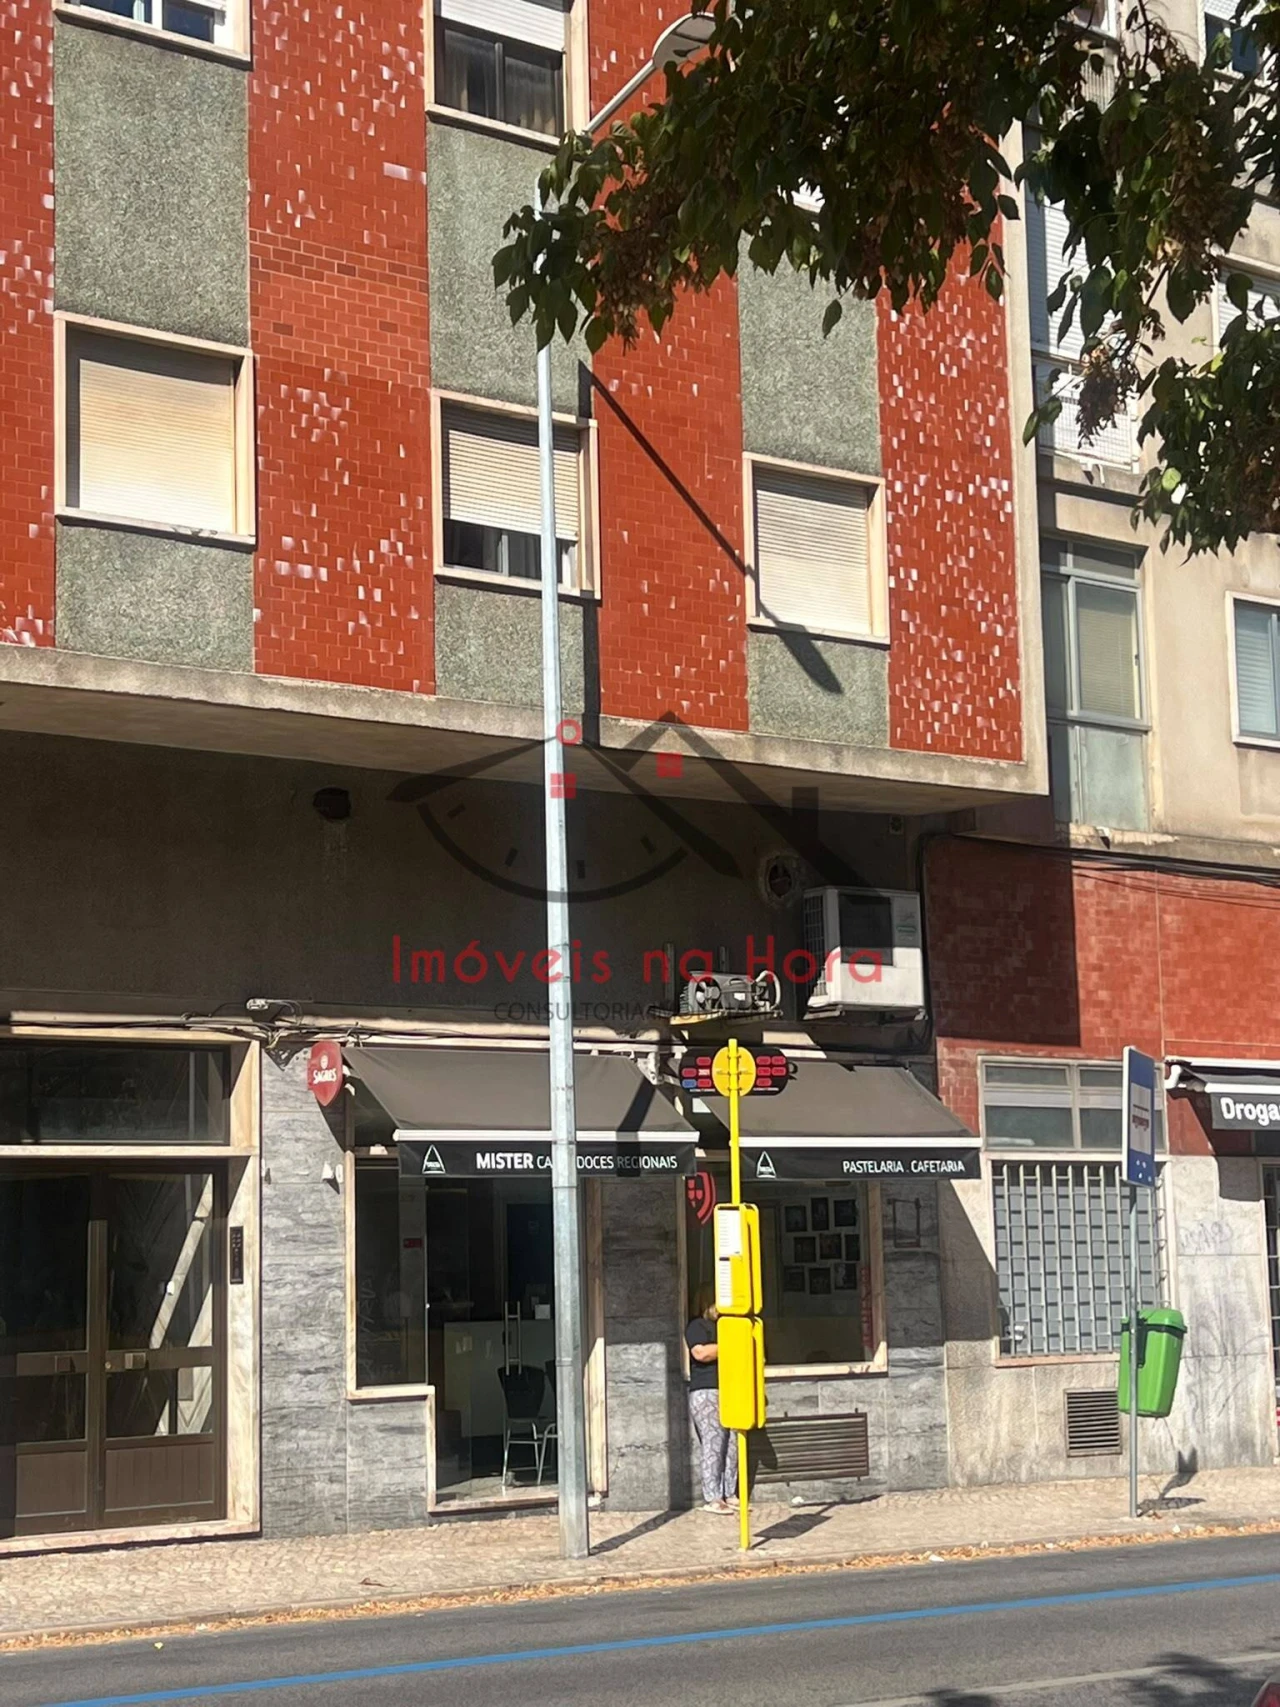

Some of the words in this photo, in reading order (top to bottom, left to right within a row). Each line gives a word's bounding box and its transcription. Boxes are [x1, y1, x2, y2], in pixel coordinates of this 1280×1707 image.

[1220, 1096, 1280, 1127] Droga
[475, 1152, 533, 1170] MISTER
[576, 1155, 614, 1169] DOCES
[617, 1155, 678, 1169] REGIONAIS
[842, 1159, 904, 1174] PASTELARIA
[910, 1160, 965, 1174] CAFETARIA
